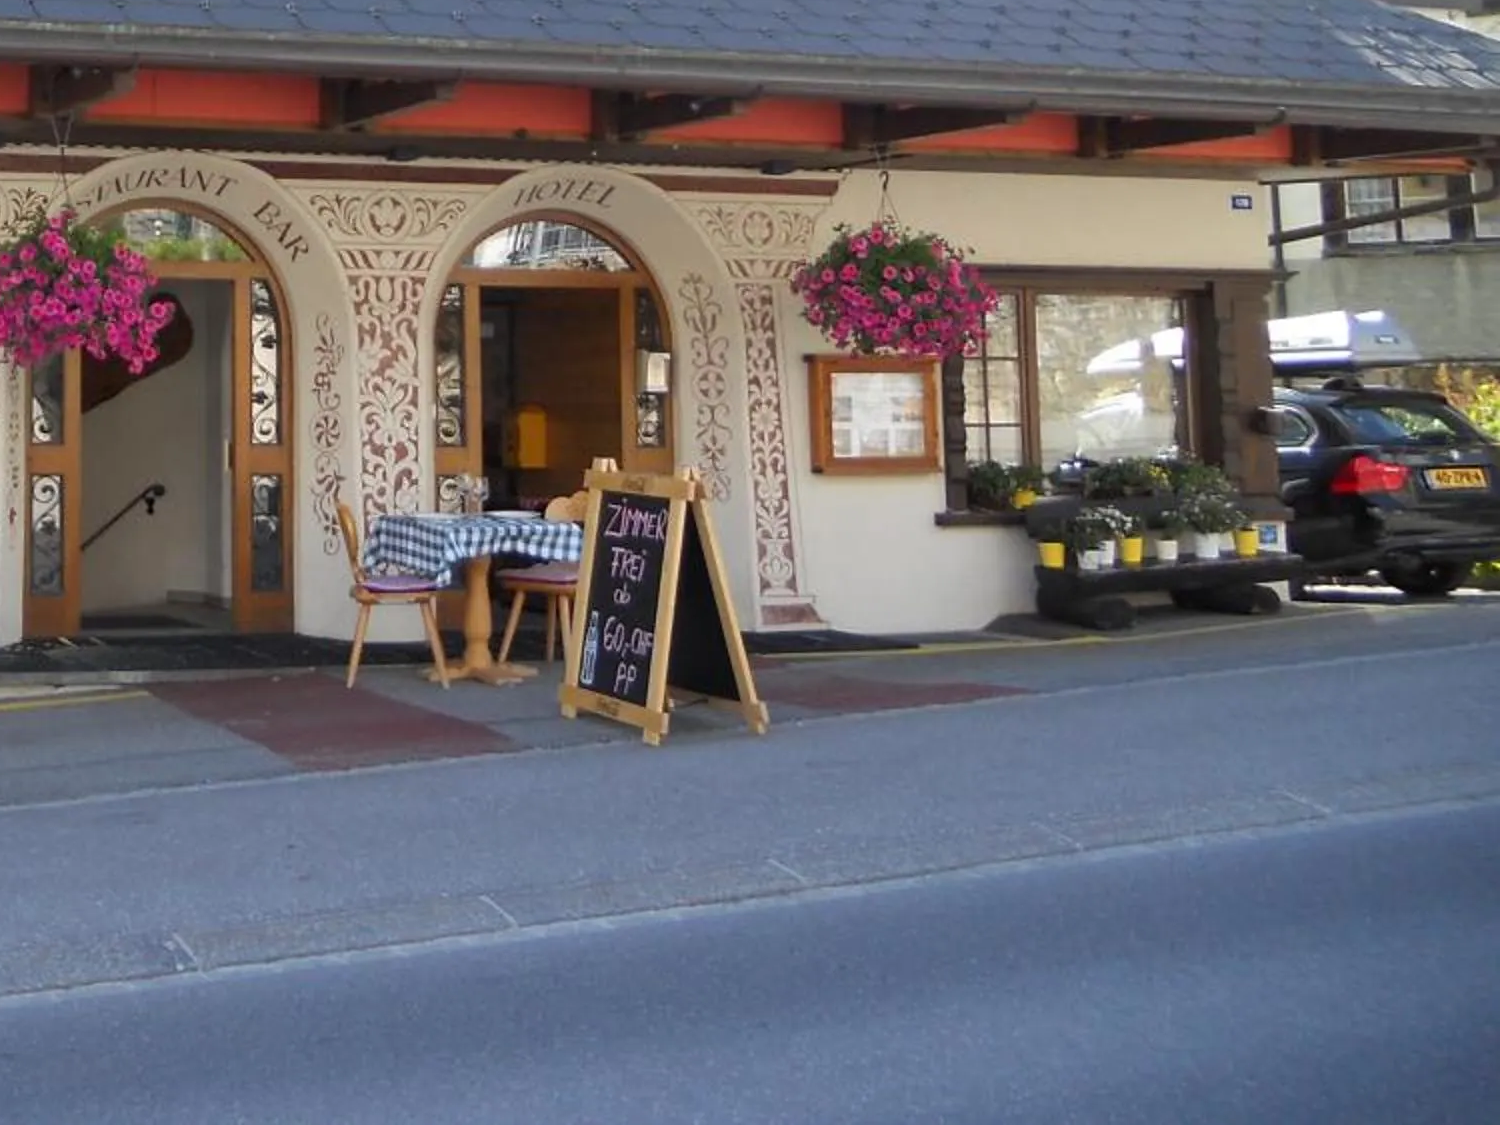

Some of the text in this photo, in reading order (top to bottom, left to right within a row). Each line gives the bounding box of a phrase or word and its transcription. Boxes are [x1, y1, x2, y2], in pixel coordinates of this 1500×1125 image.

[513, 179, 616, 209] HOTEL
[75, 166, 309, 263] STAURANT BAR
[613, 581, 631, 604] ab
